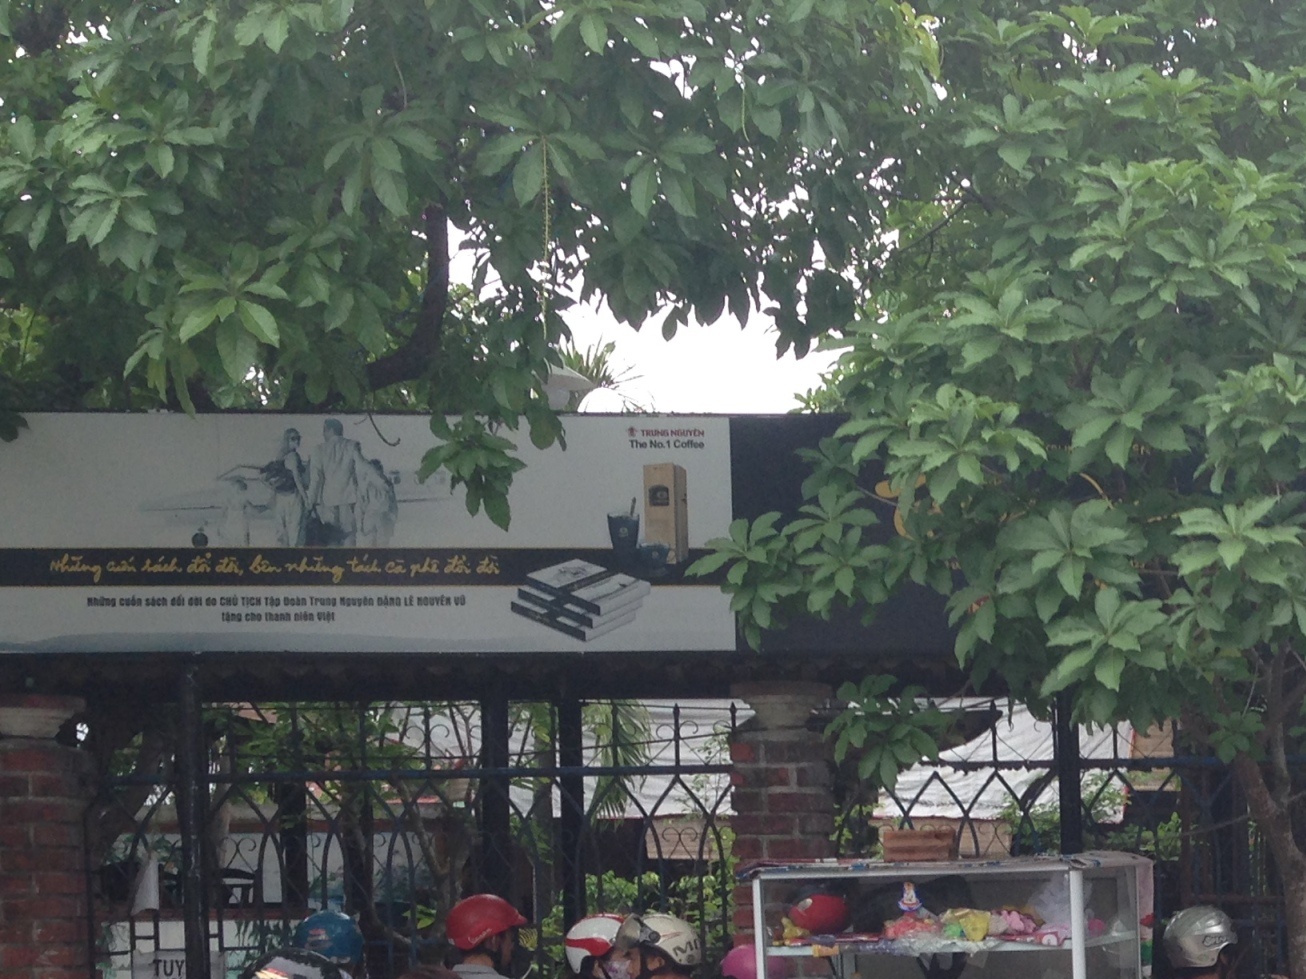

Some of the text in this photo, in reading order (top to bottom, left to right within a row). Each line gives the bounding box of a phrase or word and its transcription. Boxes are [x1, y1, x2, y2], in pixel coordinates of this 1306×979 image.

[641, 428, 670, 438] TRUNG
[629, 439, 648, 449] The
[673, 439, 705, 449] Coffee
[309, 596, 337, 608] Trung
[245, 611, 263, 622] cho
[265, 611, 292, 622] thanh
